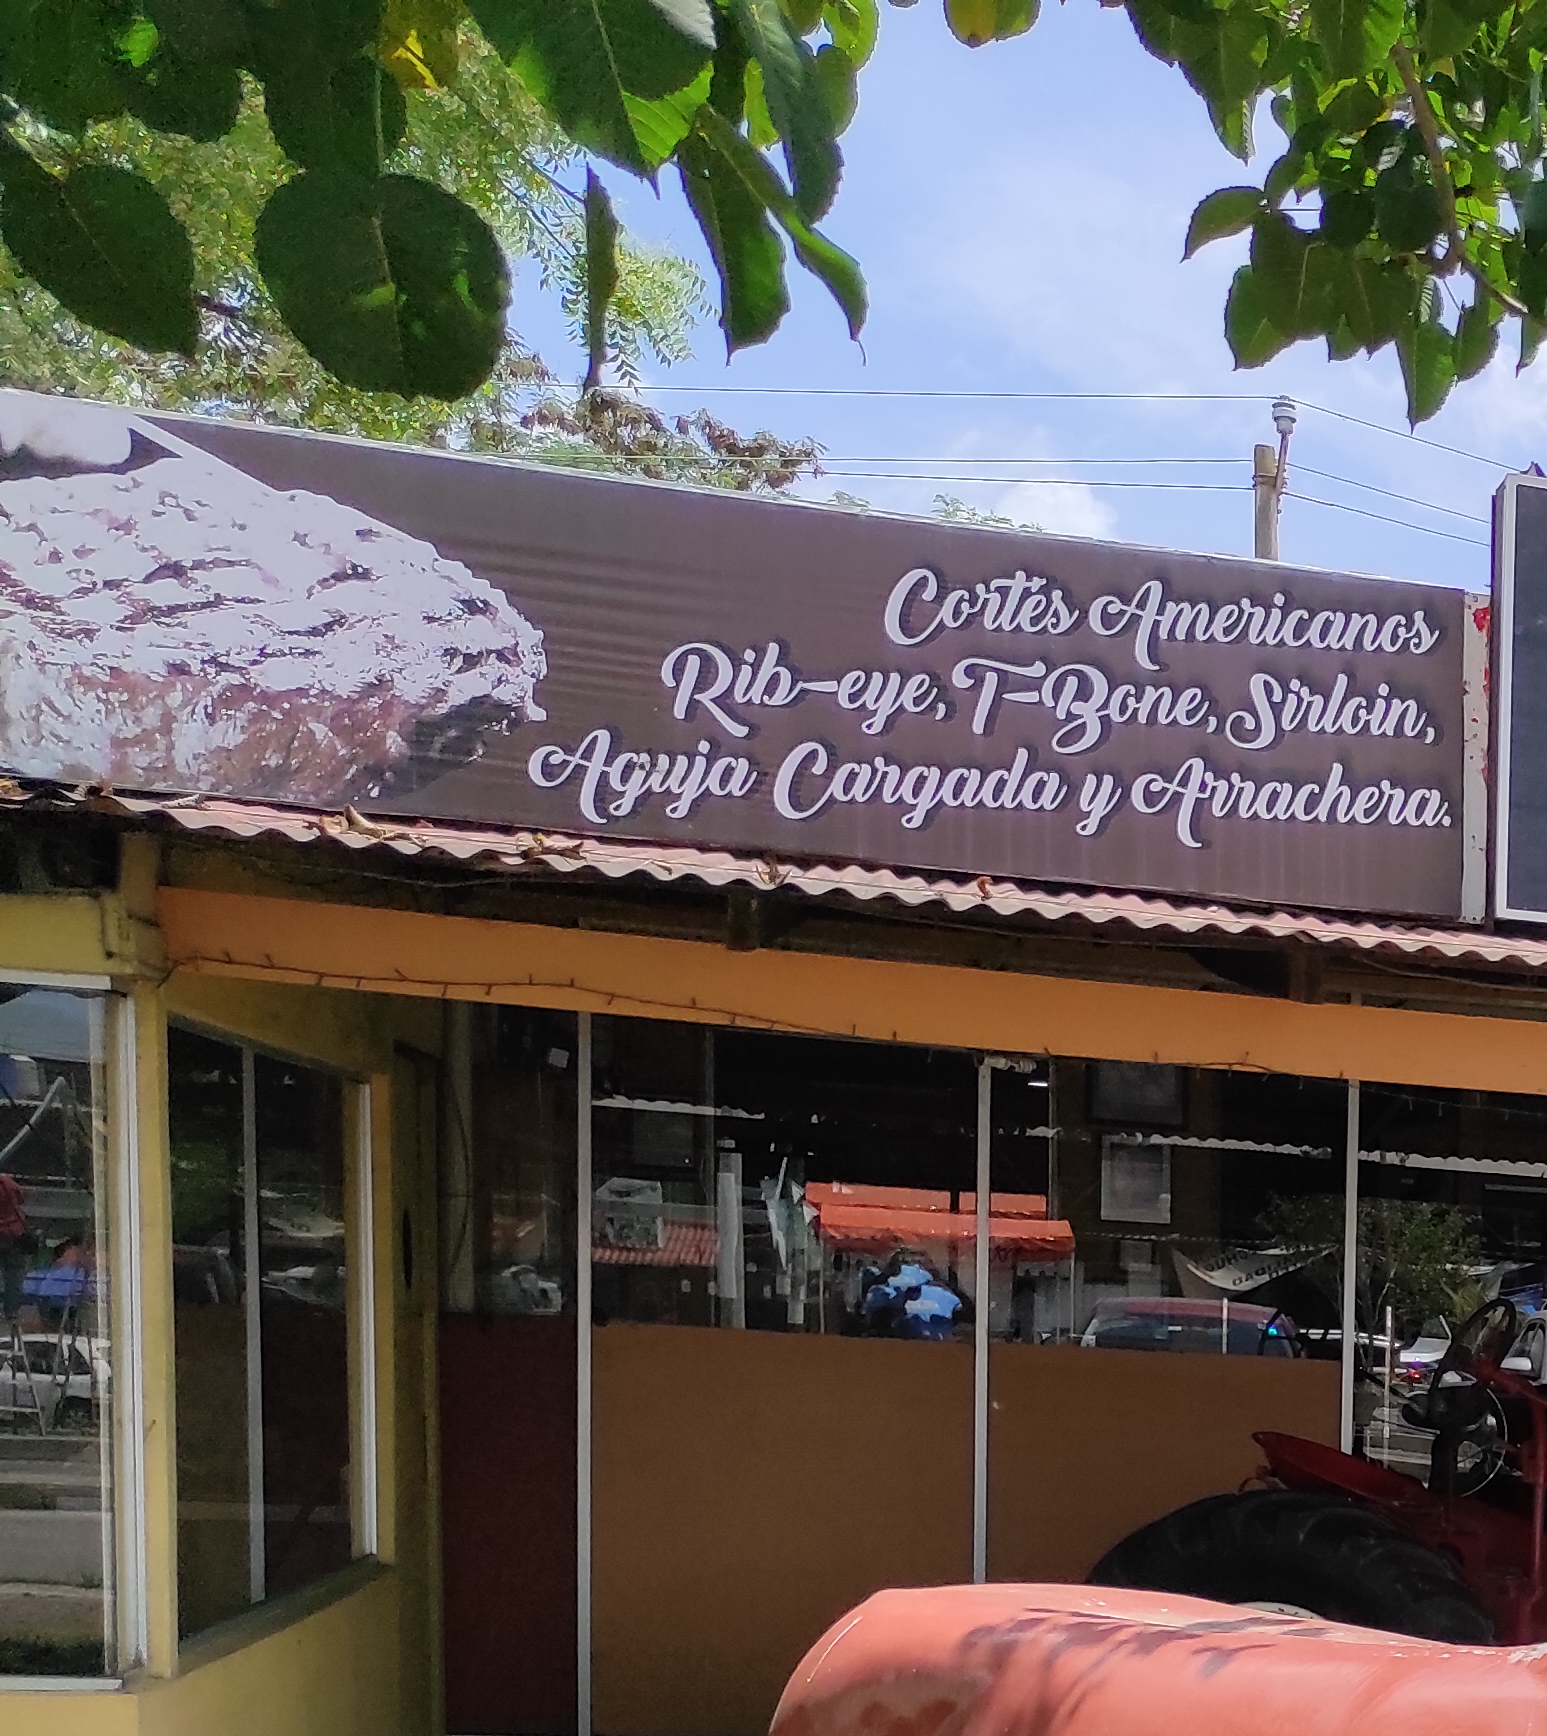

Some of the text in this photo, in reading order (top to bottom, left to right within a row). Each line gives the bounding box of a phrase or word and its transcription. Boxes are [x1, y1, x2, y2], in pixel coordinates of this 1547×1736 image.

[884, 568, 1440, 671] Cortés Americanos
[660, 641, 1437, 755] Rib-eye, T-Bone, Sirloin,
[527, 729, 1453, 848] Aguja Cargada y Arrachera.
